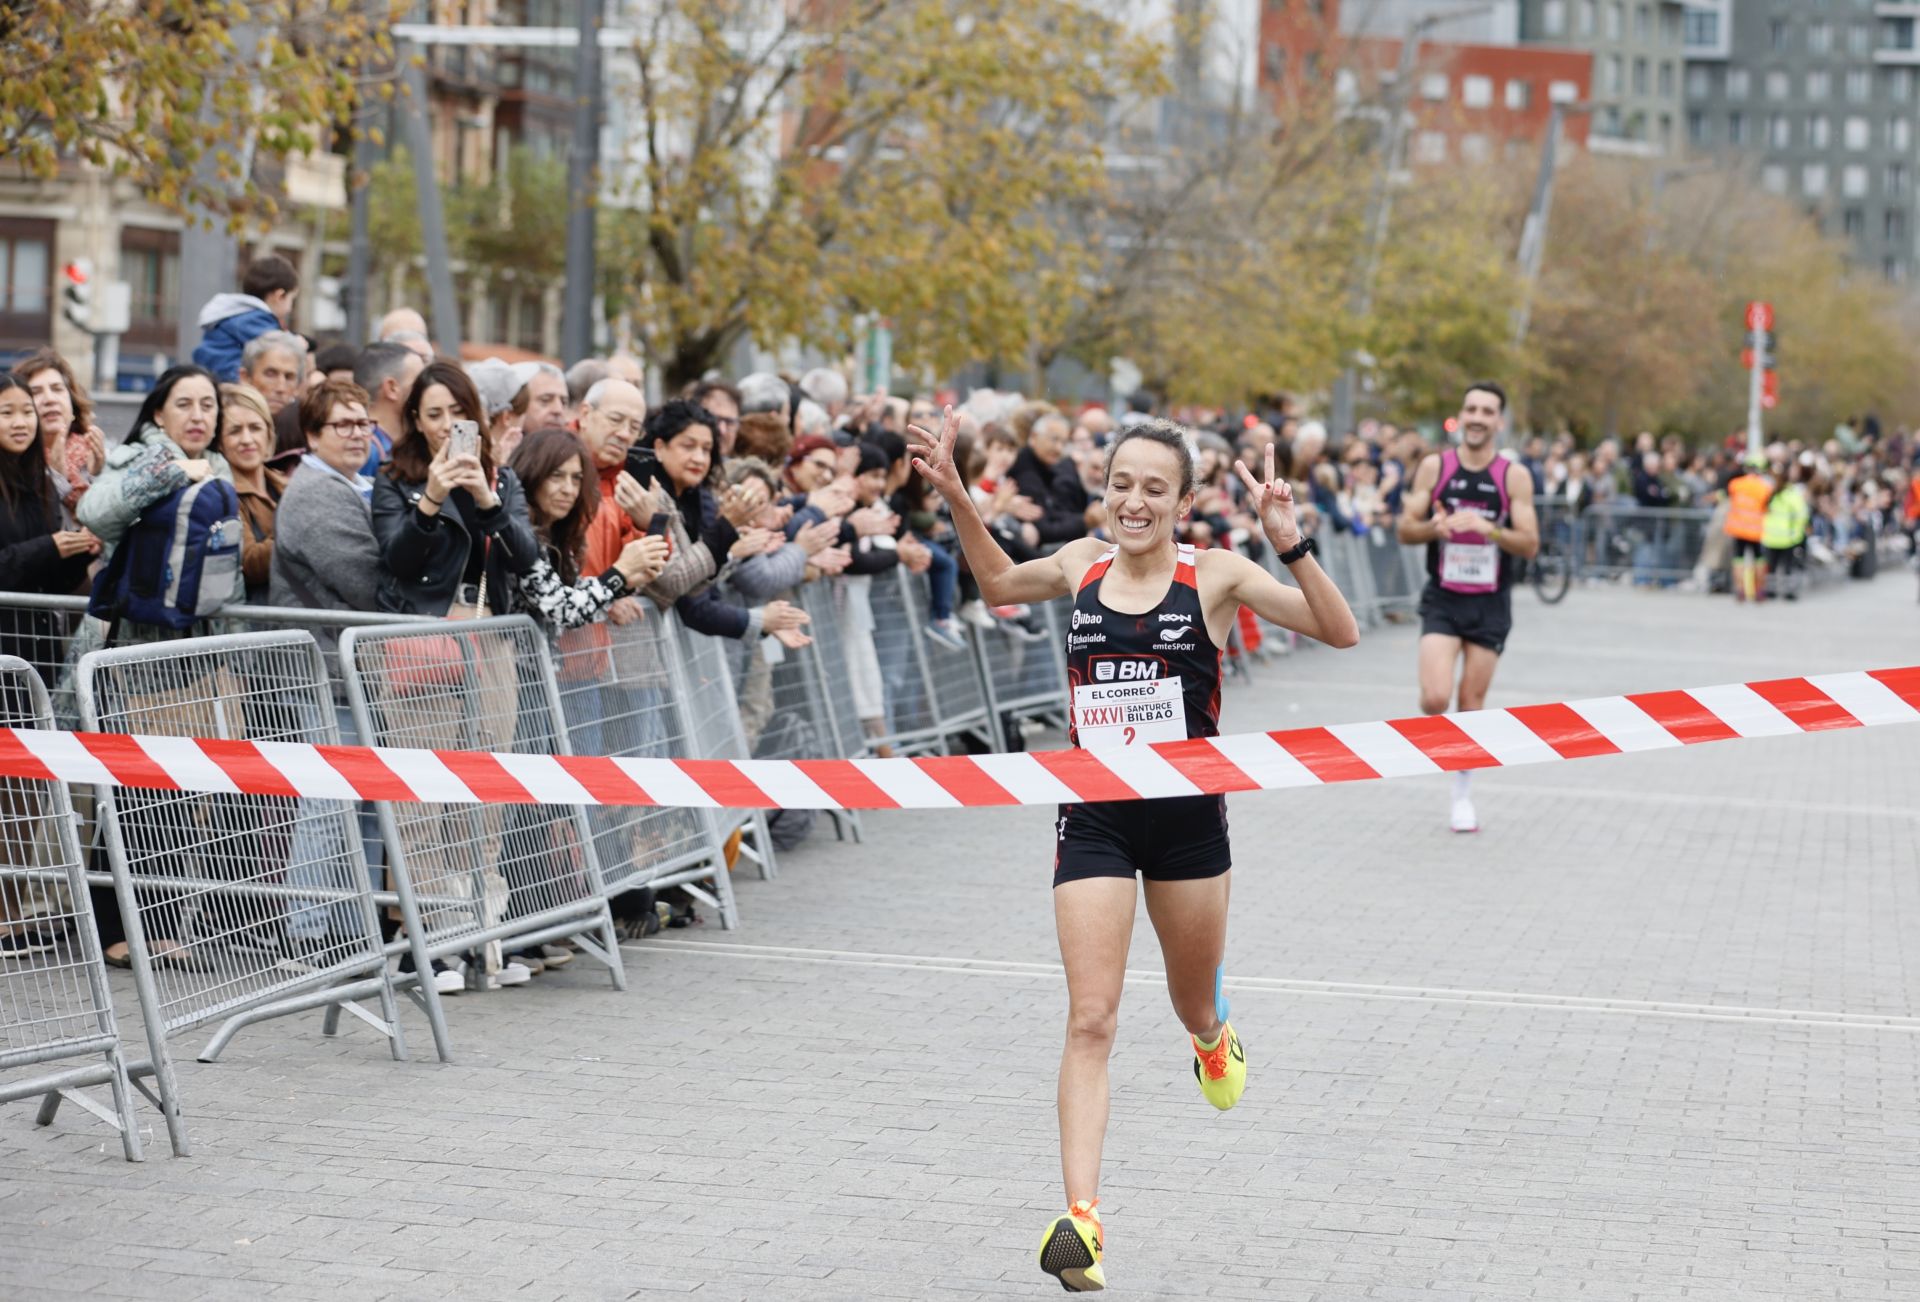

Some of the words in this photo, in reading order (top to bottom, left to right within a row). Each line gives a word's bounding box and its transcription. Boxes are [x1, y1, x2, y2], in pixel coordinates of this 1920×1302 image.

[1072, 611, 1102, 628] Bilbao
[1152, 643, 1195, 651] emteSPORT
[1119, 661, 1158, 680] BM
[1092, 691, 1104, 699] EL
[1107, 687, 1155, 698] CORREO
[1127, 702, 1172, 712] SANTURCE
[1083, 707, 1124, 726] XXXVI
[1128, 710, 1173, 722] BILBAO
